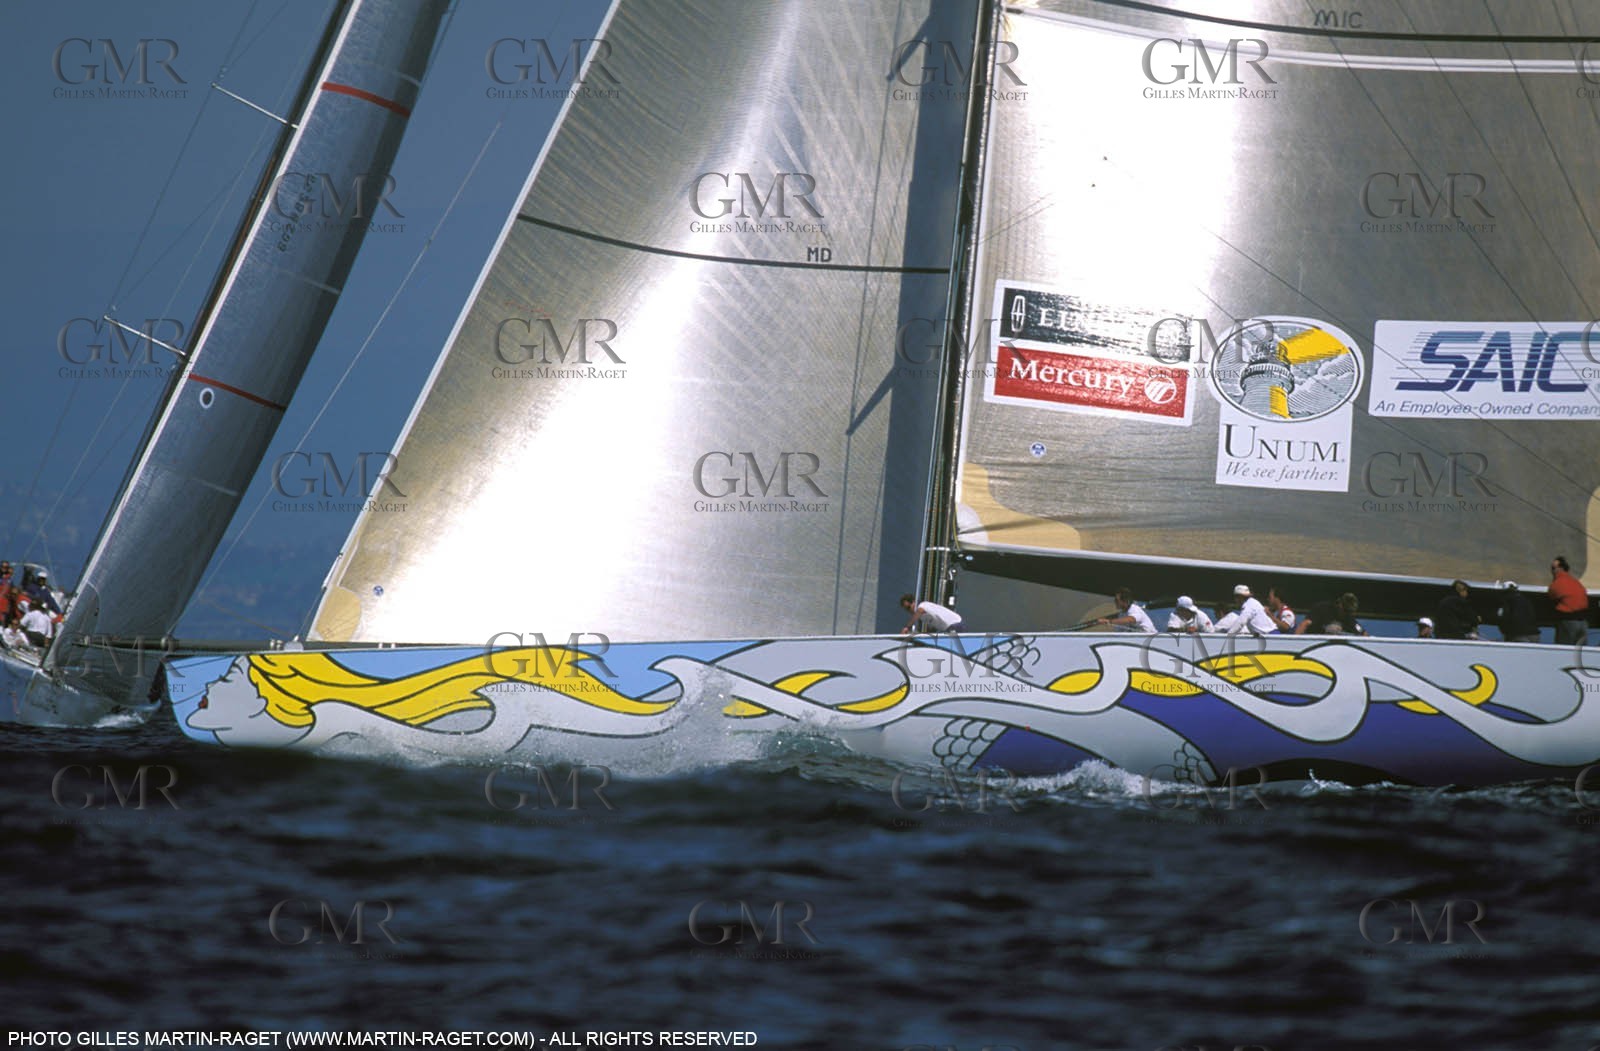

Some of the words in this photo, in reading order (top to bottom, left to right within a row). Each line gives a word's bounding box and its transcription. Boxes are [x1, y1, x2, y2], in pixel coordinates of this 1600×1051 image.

[807, 247, 832, 262] MD
[1394, 331, 1600, 392] SAIC
[1009, 357, 1136, 398] Mercury
[1374, 400, 1395, 412] An
[1399, 401, 1533, 415] Employee-Owned
[1226, 461, 1249, 475] We
[1253, 466, 1275, 478] see
[1275, 465, 1338, 482] farther.
